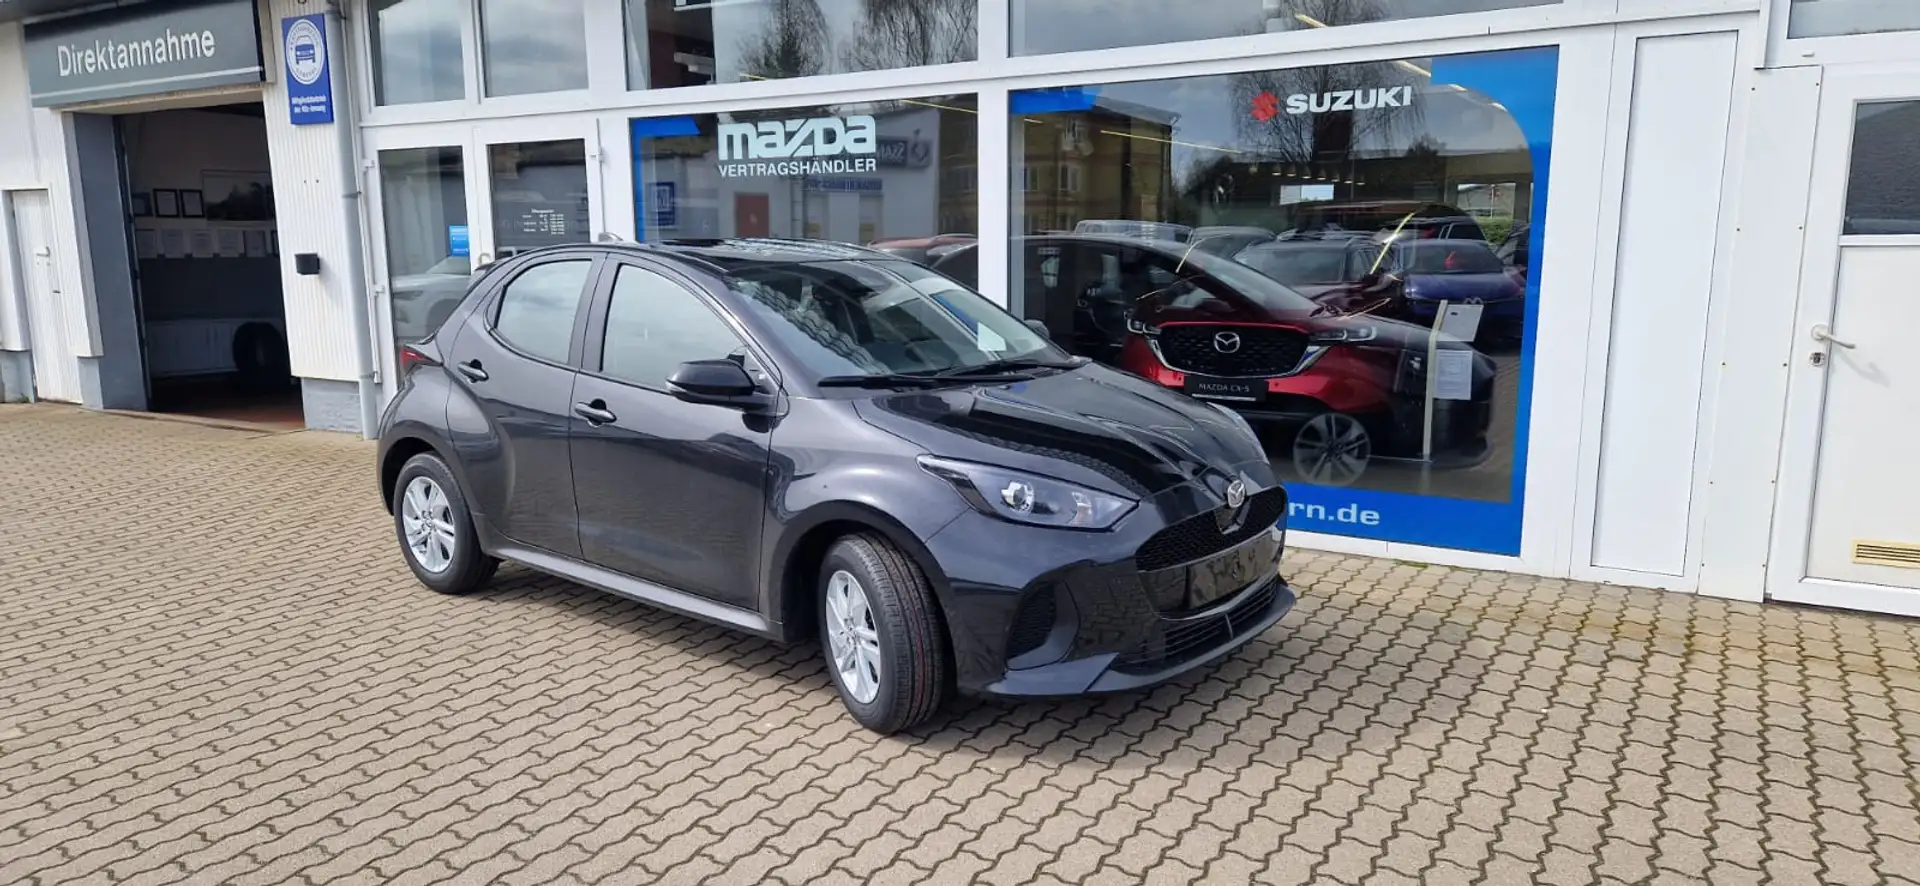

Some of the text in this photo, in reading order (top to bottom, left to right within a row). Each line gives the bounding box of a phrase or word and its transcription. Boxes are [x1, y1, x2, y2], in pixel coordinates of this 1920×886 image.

[57, 28, 216, 77] Direktannahme
[1286, 85, 1412, 115] SUZUKI
[718, 157, 877, 178] VERTRAGSHÄNDLER
[1199, 383, 1250, 393] MAZDA CX-5
[1288, 502, 1381, 526] rn.de
